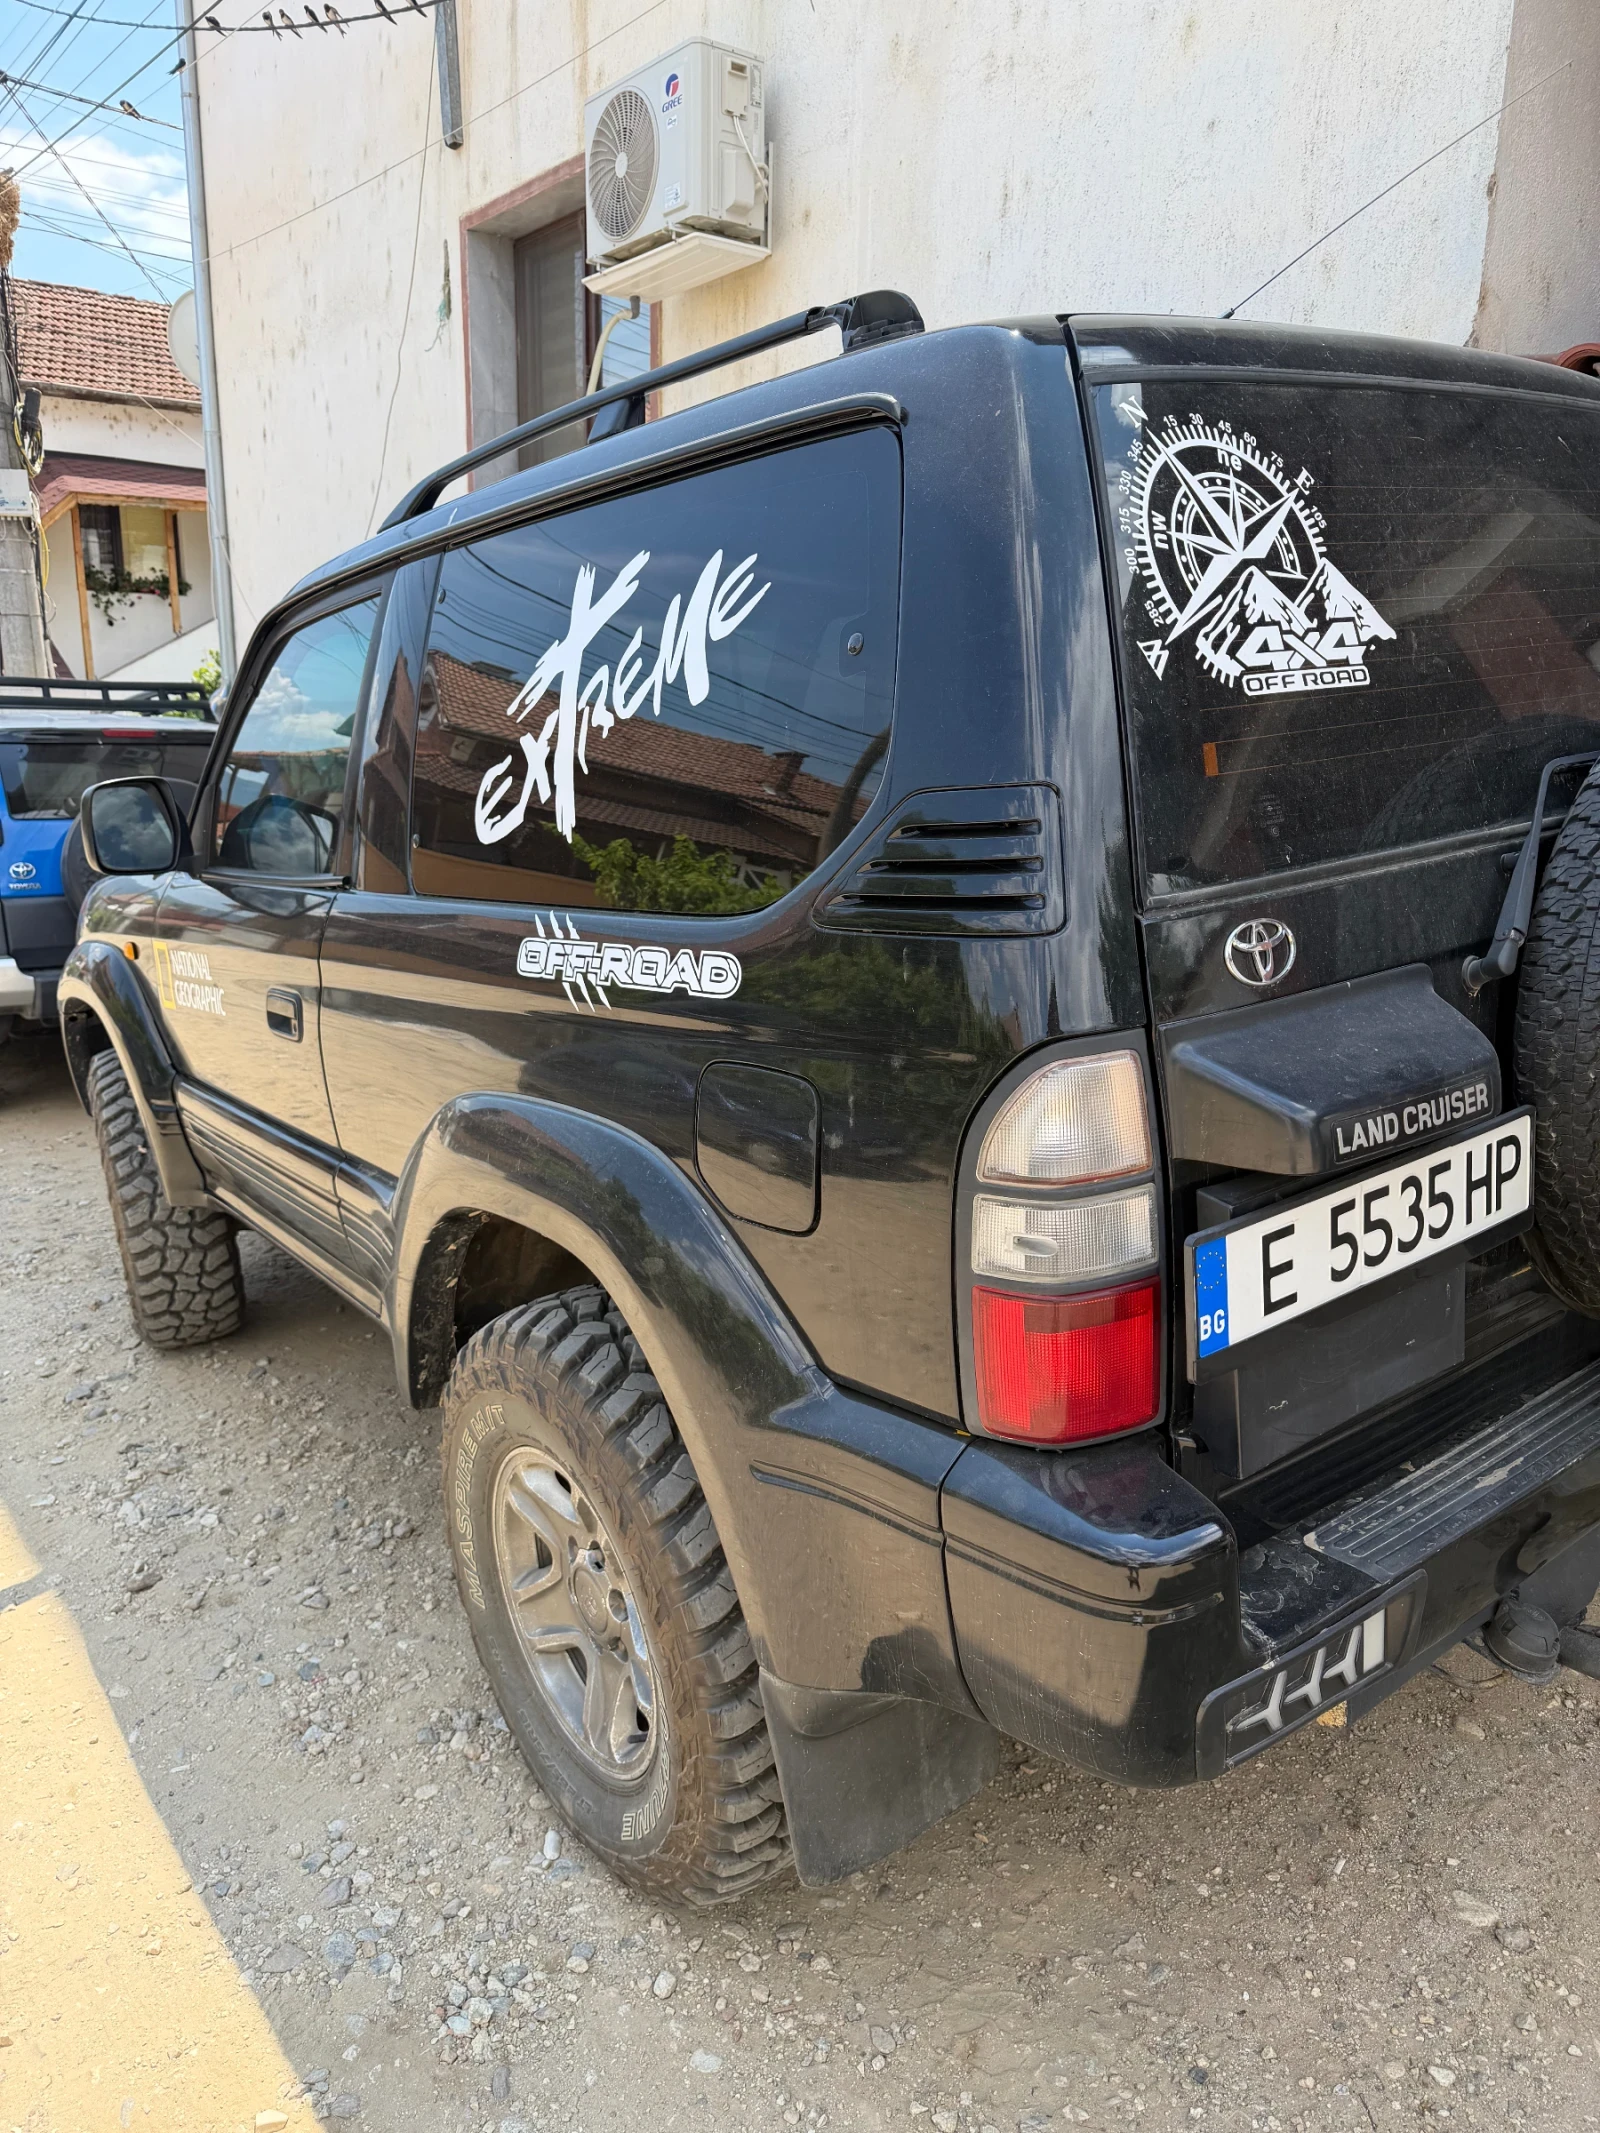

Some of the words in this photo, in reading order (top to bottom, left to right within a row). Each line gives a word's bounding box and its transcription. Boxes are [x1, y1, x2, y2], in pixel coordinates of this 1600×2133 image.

[662, 94, 683, 113] GREE
[1118, 395, 1149, 429] N
[1163, 414, 1178, 428] 15
[1189, 412, 1204, 426] 30
[1218, 420, 1232, 434] 45
[1243, 431, 1257, 447] 60
[1126, 438, 1144, 462] 345
[1217, 448, 1242, 472] ne
[1270, 450, 1284, 468] 75
[1118, 470, 1132, 495] 330
[1293, 466, 1315, 496] E
[1118, 507, 1132, 534] 315
[1151, 510, 1169, 550] nw
[1310, 504, 1328, 529] 105
[1124, 547, 1140, 575] 300
[1143, 599, 1165, 628] 285
[1136, 638, 1170, 681] W
[1245, 673, 1296, 693] OFF
[1301, 668, 1369, 687] ROAD
[170, 950, 213, 981] NATIONAL
[174, 979, 226, 1017] GEOGRAPHIC
[1336, 1112, 1399, 1155] LAND
[1403, 1083, 1489, 1135] CRUISER
[1261, 1223, 1298, 1317] E
[1330, 1159, 1454, 1283] 5535
[1465, 1134, 1522, 1226] HP
[1199, 1308, 1226, 1341] BG
